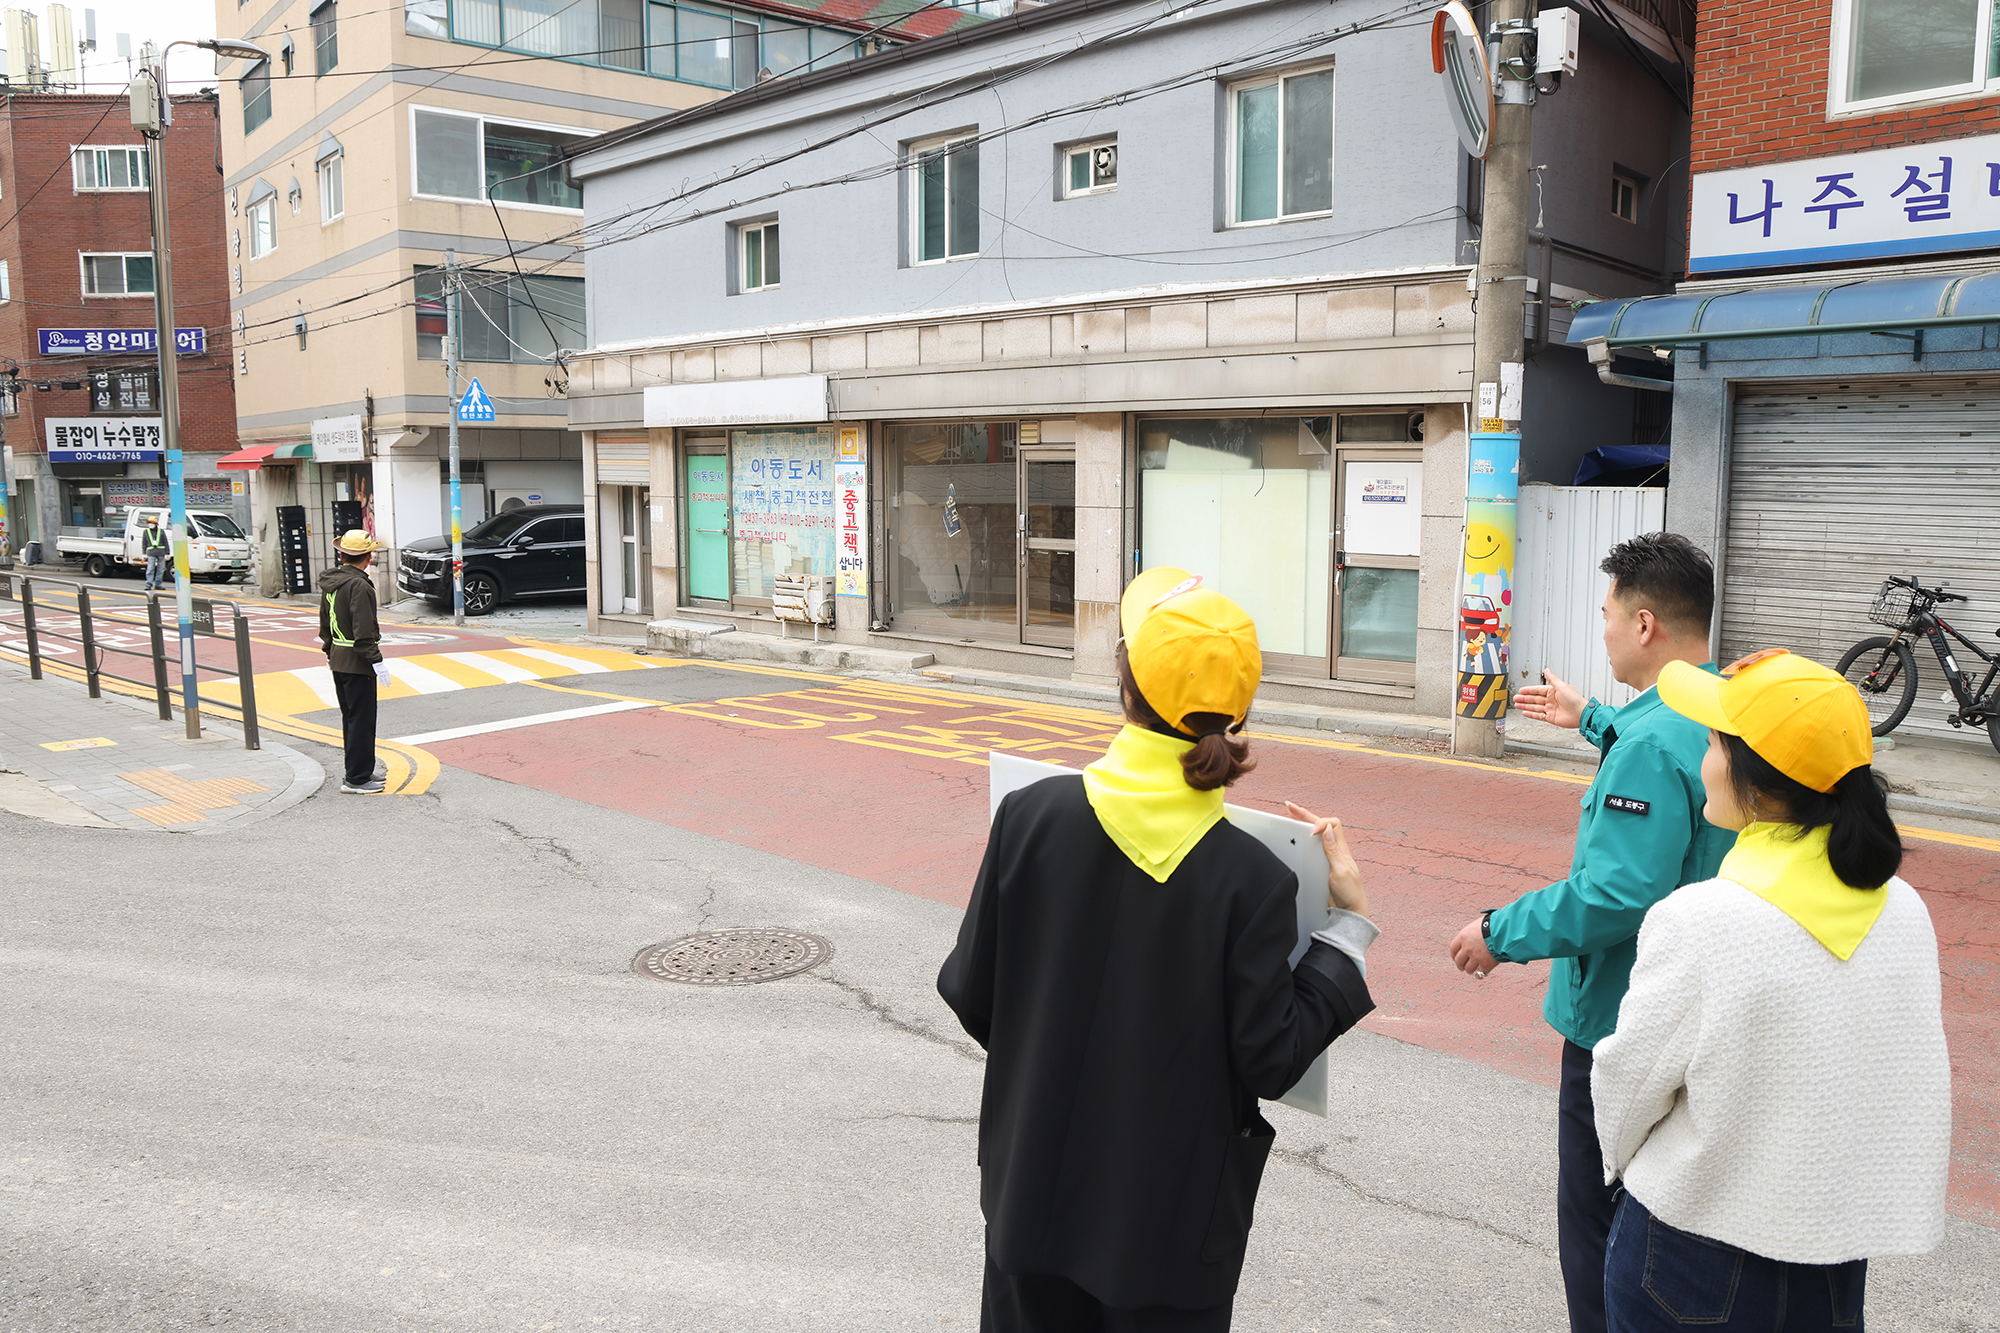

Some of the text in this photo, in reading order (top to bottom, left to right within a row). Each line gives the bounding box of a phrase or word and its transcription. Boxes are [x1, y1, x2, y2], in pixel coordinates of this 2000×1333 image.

[85, 331, 197, 351] 청안미어
[55, 423, 161, 448] 물잡이 누수탐정
[75, 452, 141, 461] 010-4626-7765
[692, 470, 724, 483] 아동도서
[750, 458, 822, 481] 아동도서
[837, 472, 864, 487] 아동도서
[109, 495, 166, 505] 010-4626-765
[843, 489, 859, 555] 중고책
[740, 530, 787, 543] 중고책 삽니다
[839, 557, 864, 571] 삽니다
[1462, 686, 1476, 697] 위험
[660, 685, 976, 730] CCTV
[1609, 797, 1645, 811] 서울 도봉구
